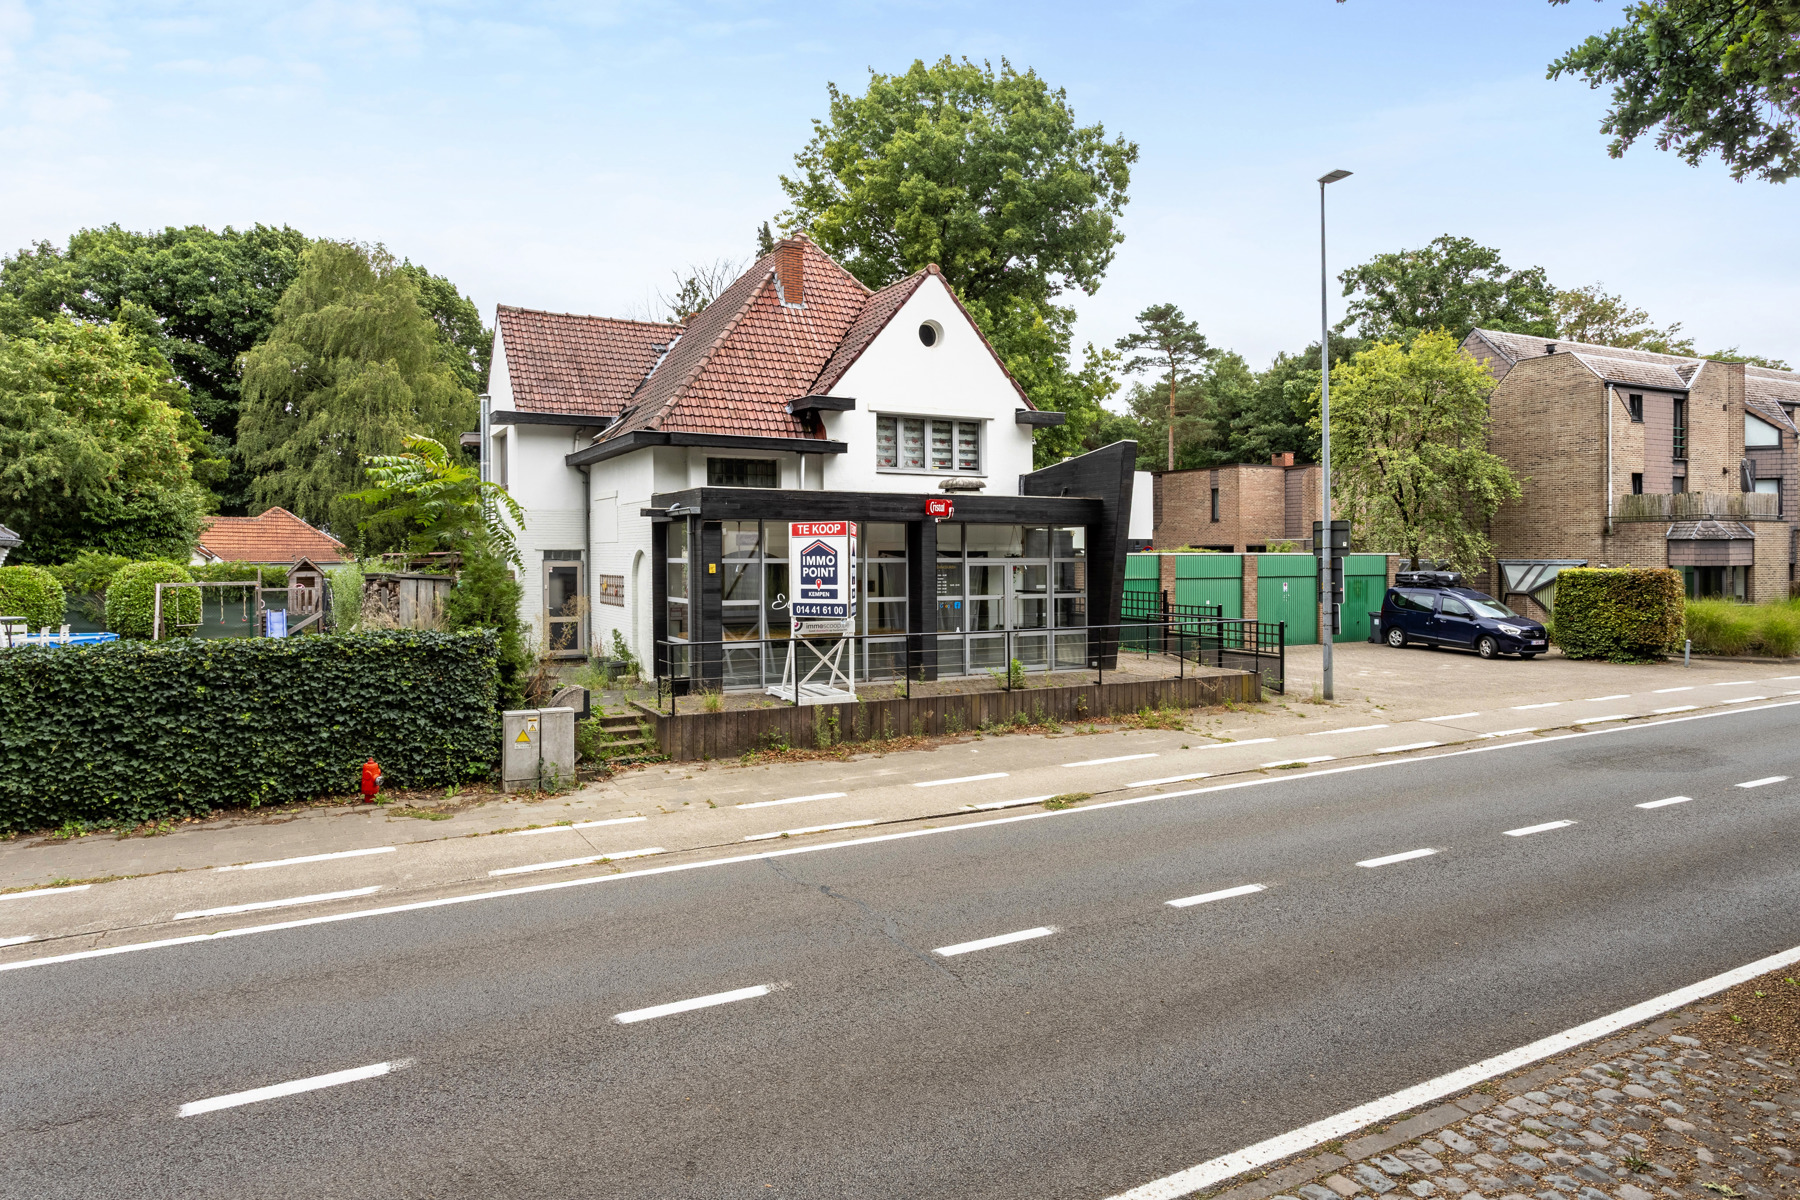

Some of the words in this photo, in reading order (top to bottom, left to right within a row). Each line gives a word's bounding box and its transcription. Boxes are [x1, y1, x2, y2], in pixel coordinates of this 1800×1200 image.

[930, 501, 945, 513] Cristal
[797, 524, 810, 534] TE
[812, 524, 841, 534] KOOP
[802, 555, 836, 566] IMMO
[802, 567, 836, 577] POINT
[796, 605, 810, 614] 014
[811, 605, 820, 614] 41
[822, 606, 831, 614] 61
[833, 606, 844, 615] 00
